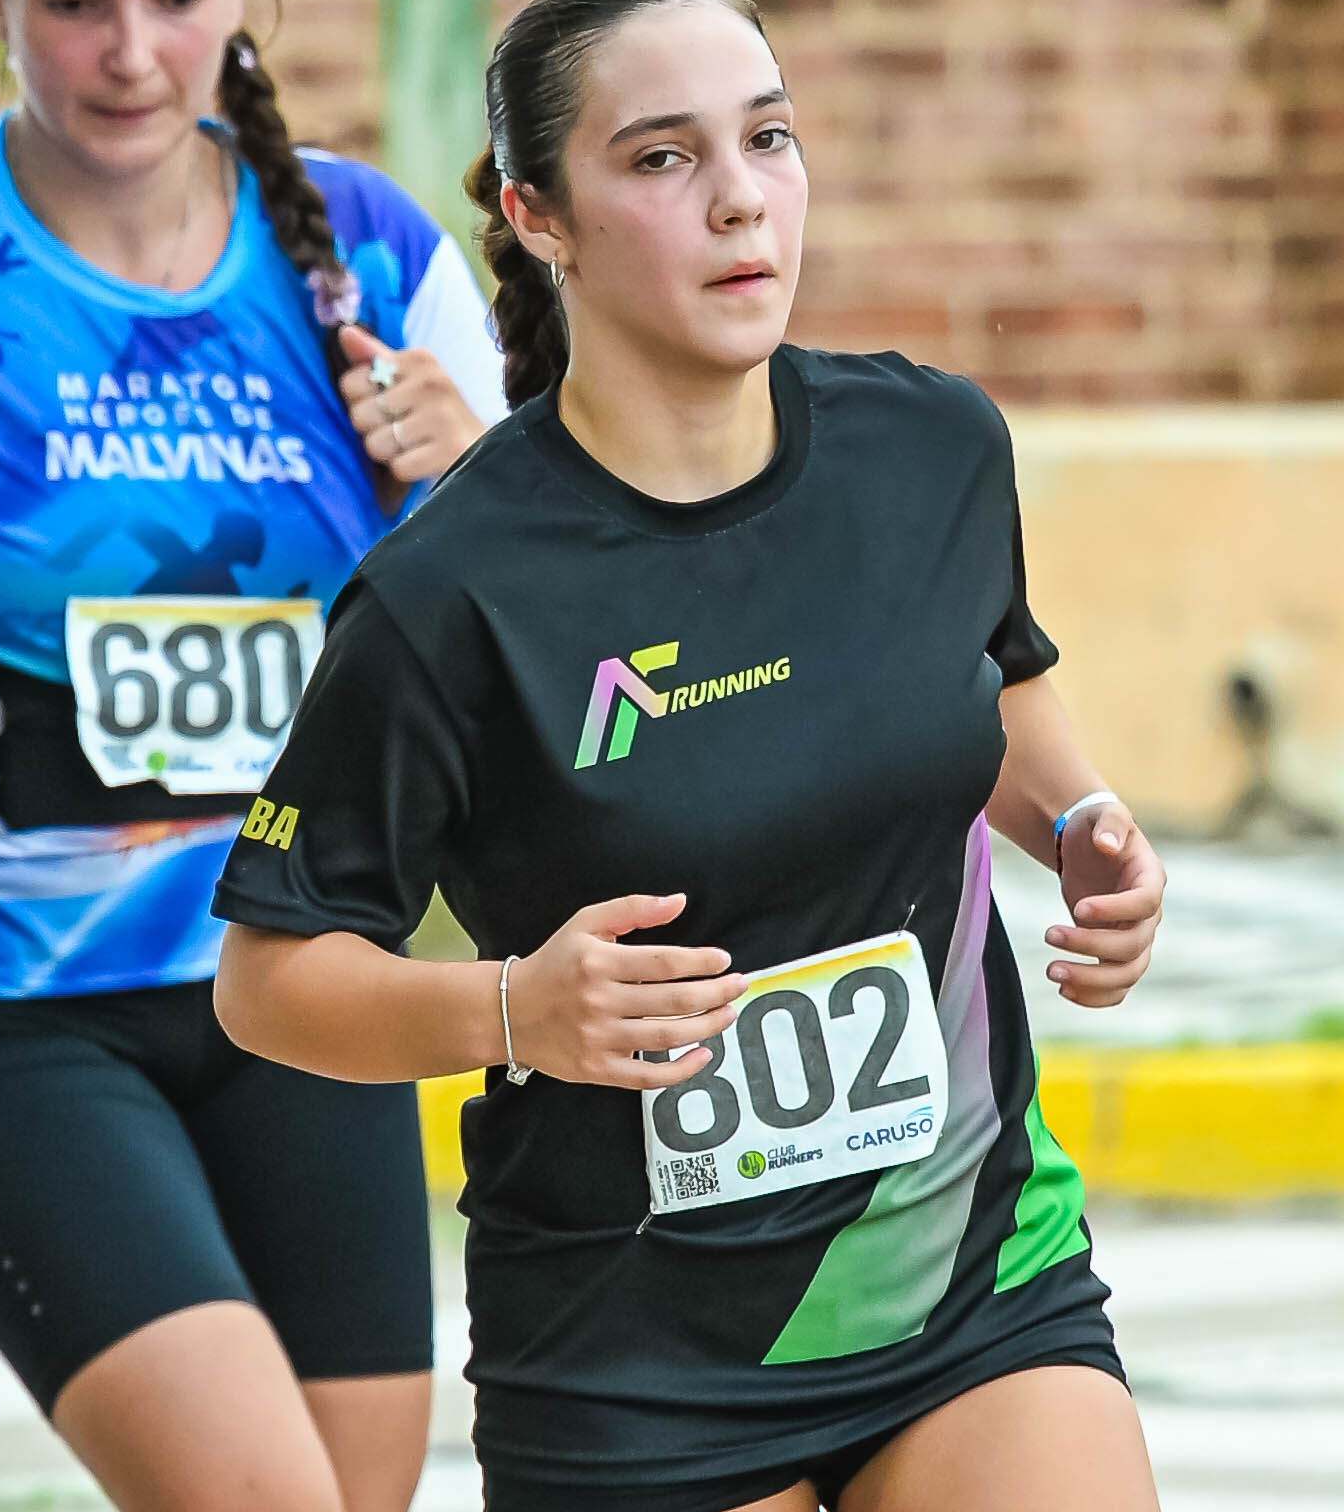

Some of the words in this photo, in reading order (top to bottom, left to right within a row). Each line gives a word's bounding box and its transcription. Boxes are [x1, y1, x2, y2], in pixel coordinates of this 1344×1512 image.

[45, 429, 312, 483] MALVINAS
[92, 620, 302, 738] 680
[671, 656, 791, 713] RUNNING
[642, 966, 931, 1153] 802
[767, 1144, 796, 1159] CLUB
[846, 1118, 933, 1151] CARUSO
